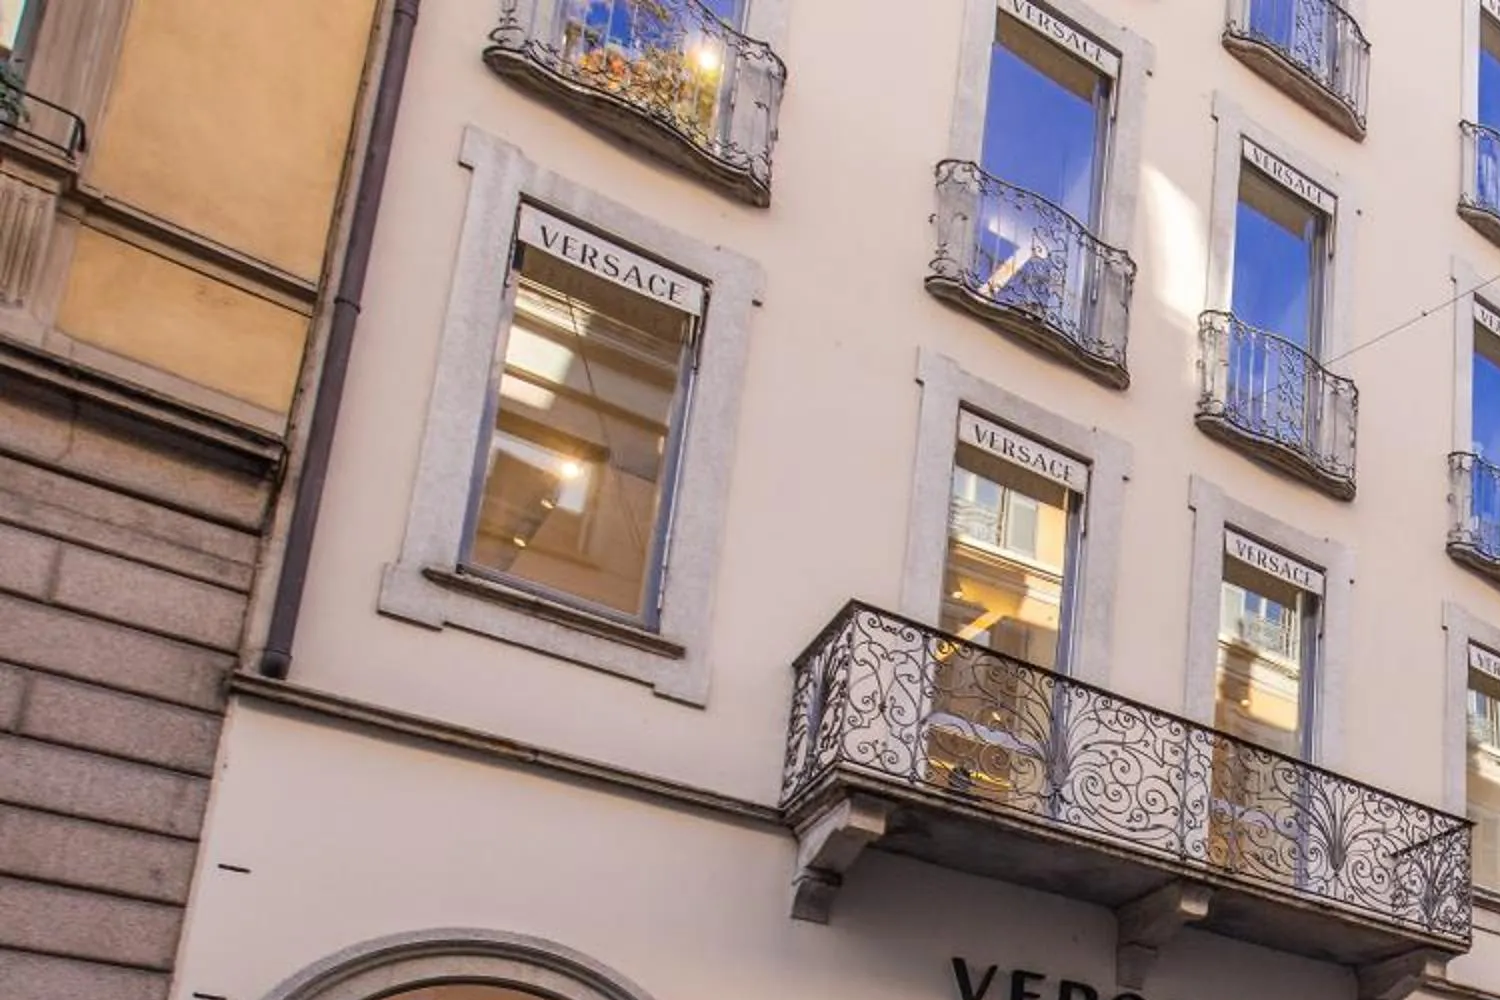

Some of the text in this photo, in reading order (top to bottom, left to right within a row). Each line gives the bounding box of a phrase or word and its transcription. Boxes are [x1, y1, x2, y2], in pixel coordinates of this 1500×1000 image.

[1013, 0, 1106, 67] VERSACE
[1253, 147, 1326, 207] VERSACE
[541, 225, 686, 304] VERSACE
[975, 423, 1074, 484] VERSACE
[1236, 539, 1313, 589] VERSACE
